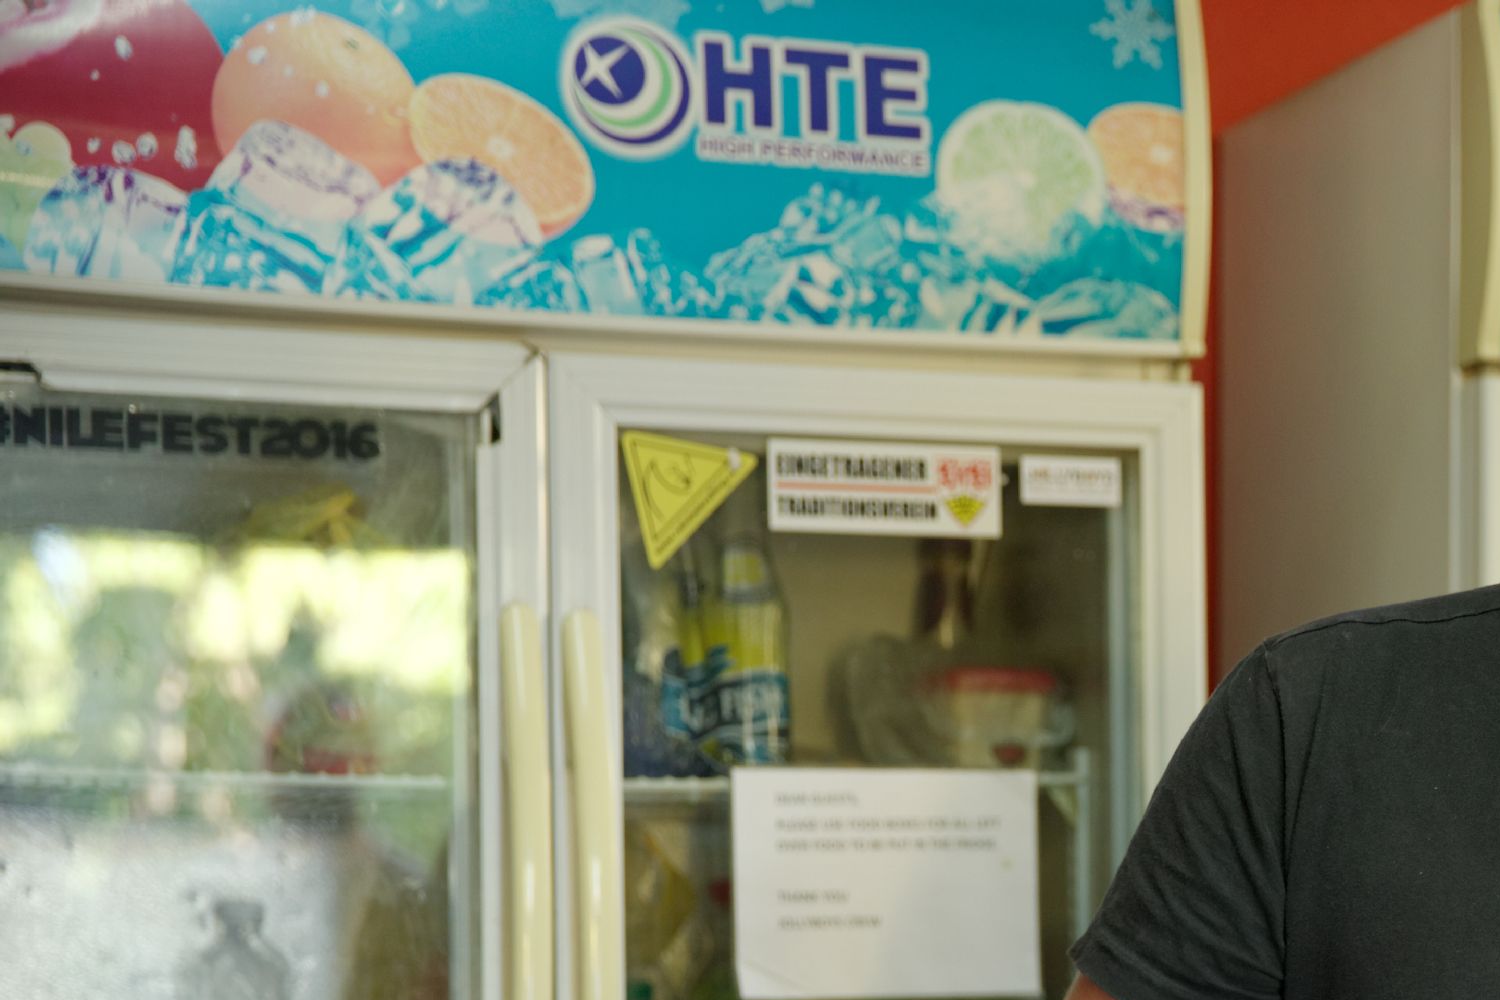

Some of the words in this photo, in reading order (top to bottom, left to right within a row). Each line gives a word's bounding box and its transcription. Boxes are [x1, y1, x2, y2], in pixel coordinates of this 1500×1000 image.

[703, 41, 922, 139] HTE
[699, 136, 754, 156] HIGH
[760, 140, 924, 169] PERFORMANCE
[776, 454, 926, 480] EINGETRAGENER
[777, 495, 937, 521] TRADITIONSVEREIN
